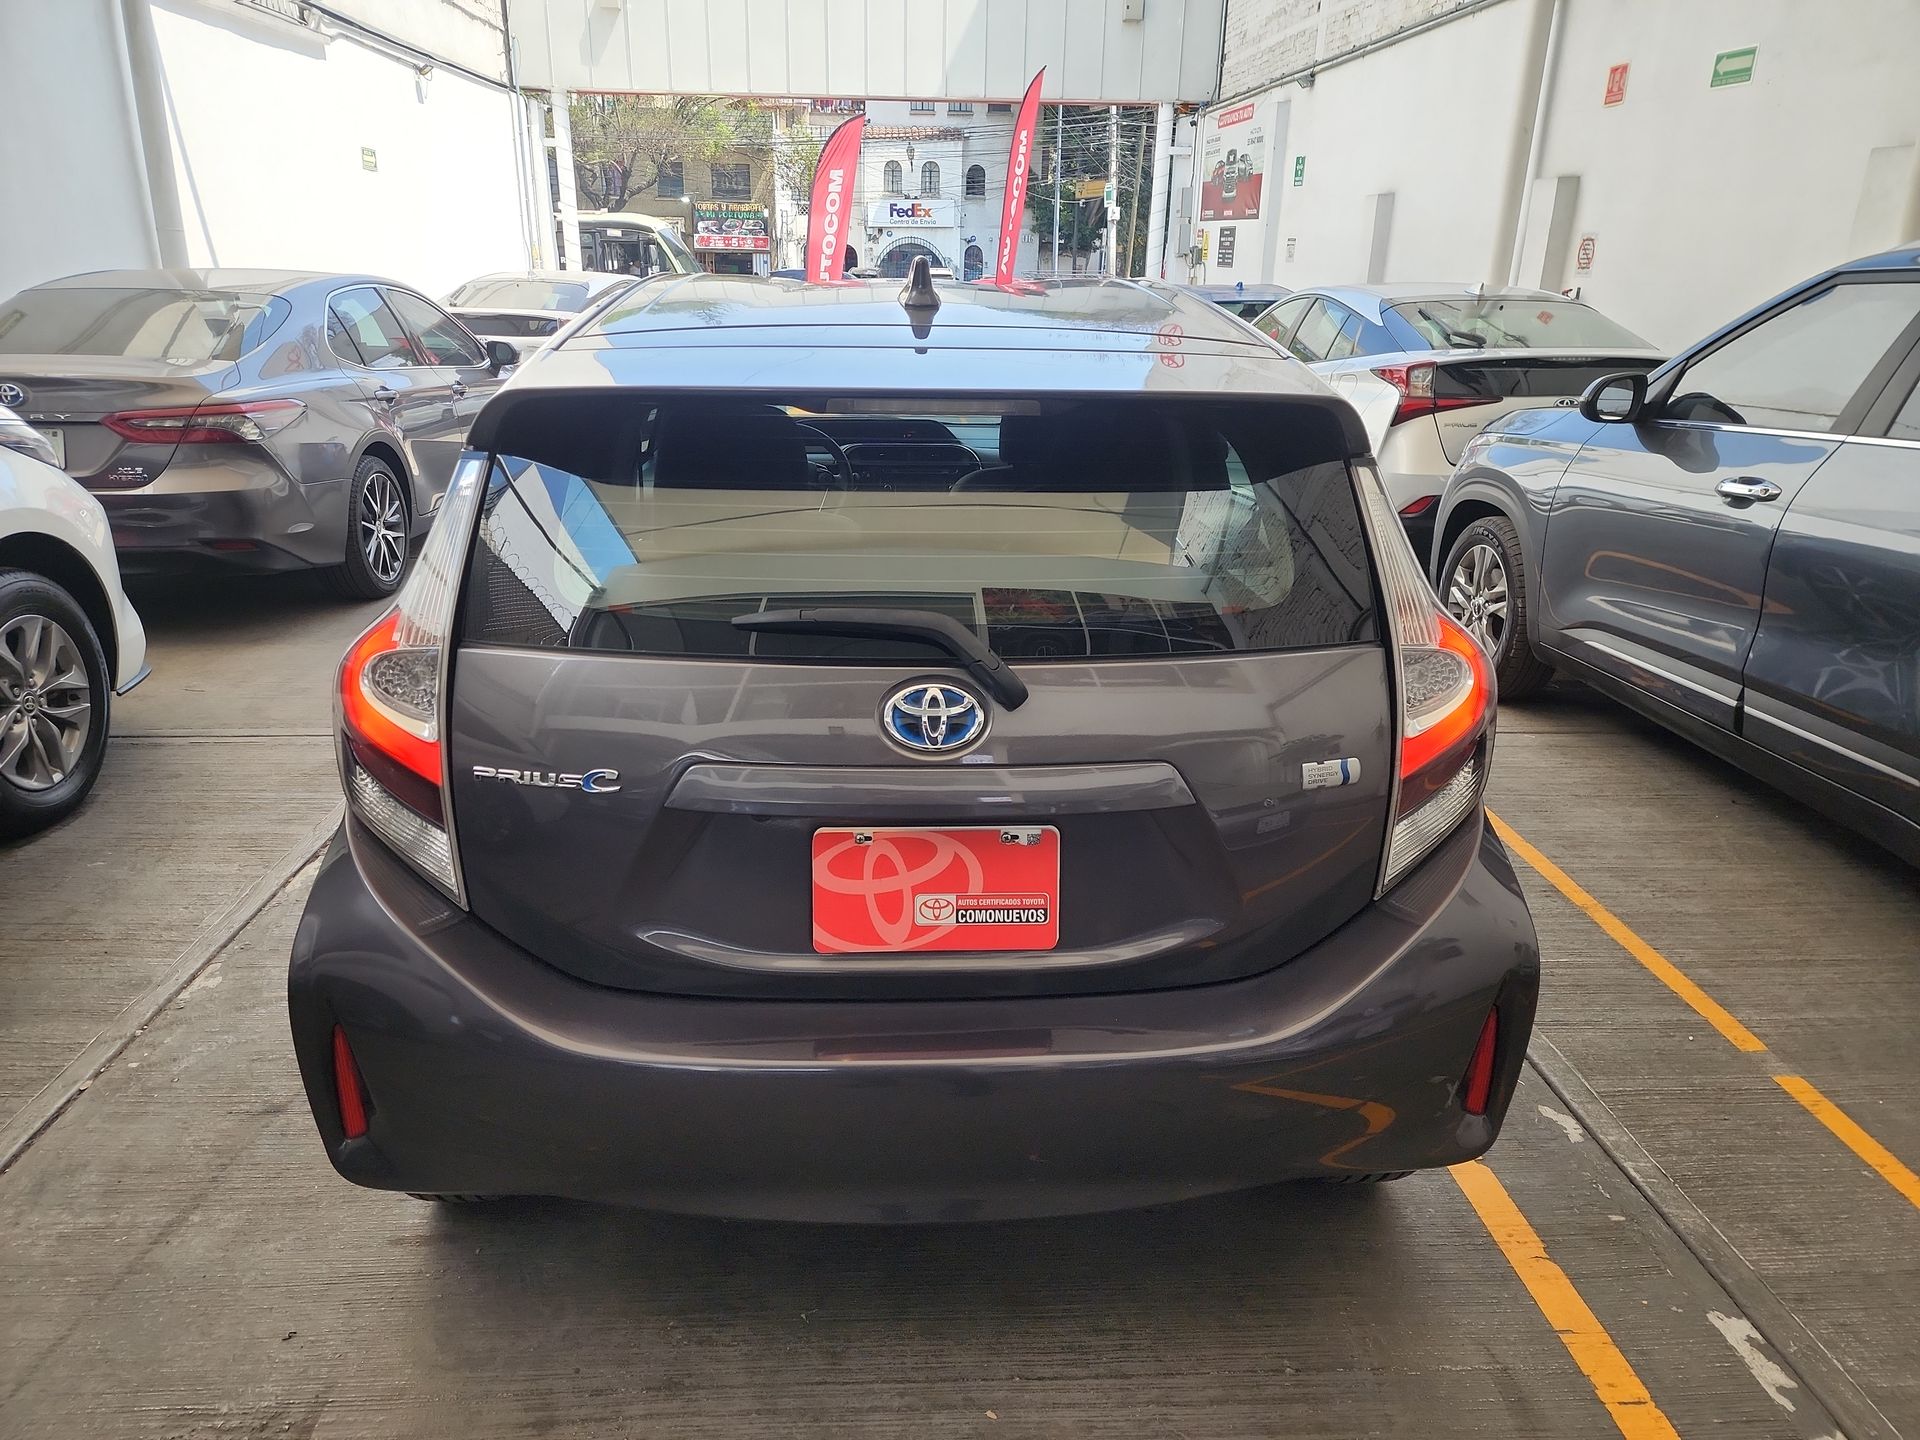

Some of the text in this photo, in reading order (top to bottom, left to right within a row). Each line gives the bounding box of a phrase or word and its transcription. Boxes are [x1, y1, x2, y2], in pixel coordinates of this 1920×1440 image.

[694, 203, 719, 211] TORTAS
[889, 203, 932, 218] FedEx
[1307, 765, 1333, 773] HYBRID
[472, 765, 583, 788] PRIUS
[1307, 771, 1339, 779] SYNERGY
[1307, 777, 1329, 785] DRIVE
[957, 898, 978, 906] AUTOS
[979, 898, 1021, 906] CERTIFICADOS
[957, 909, 1046, 923] COMONUEVOS
